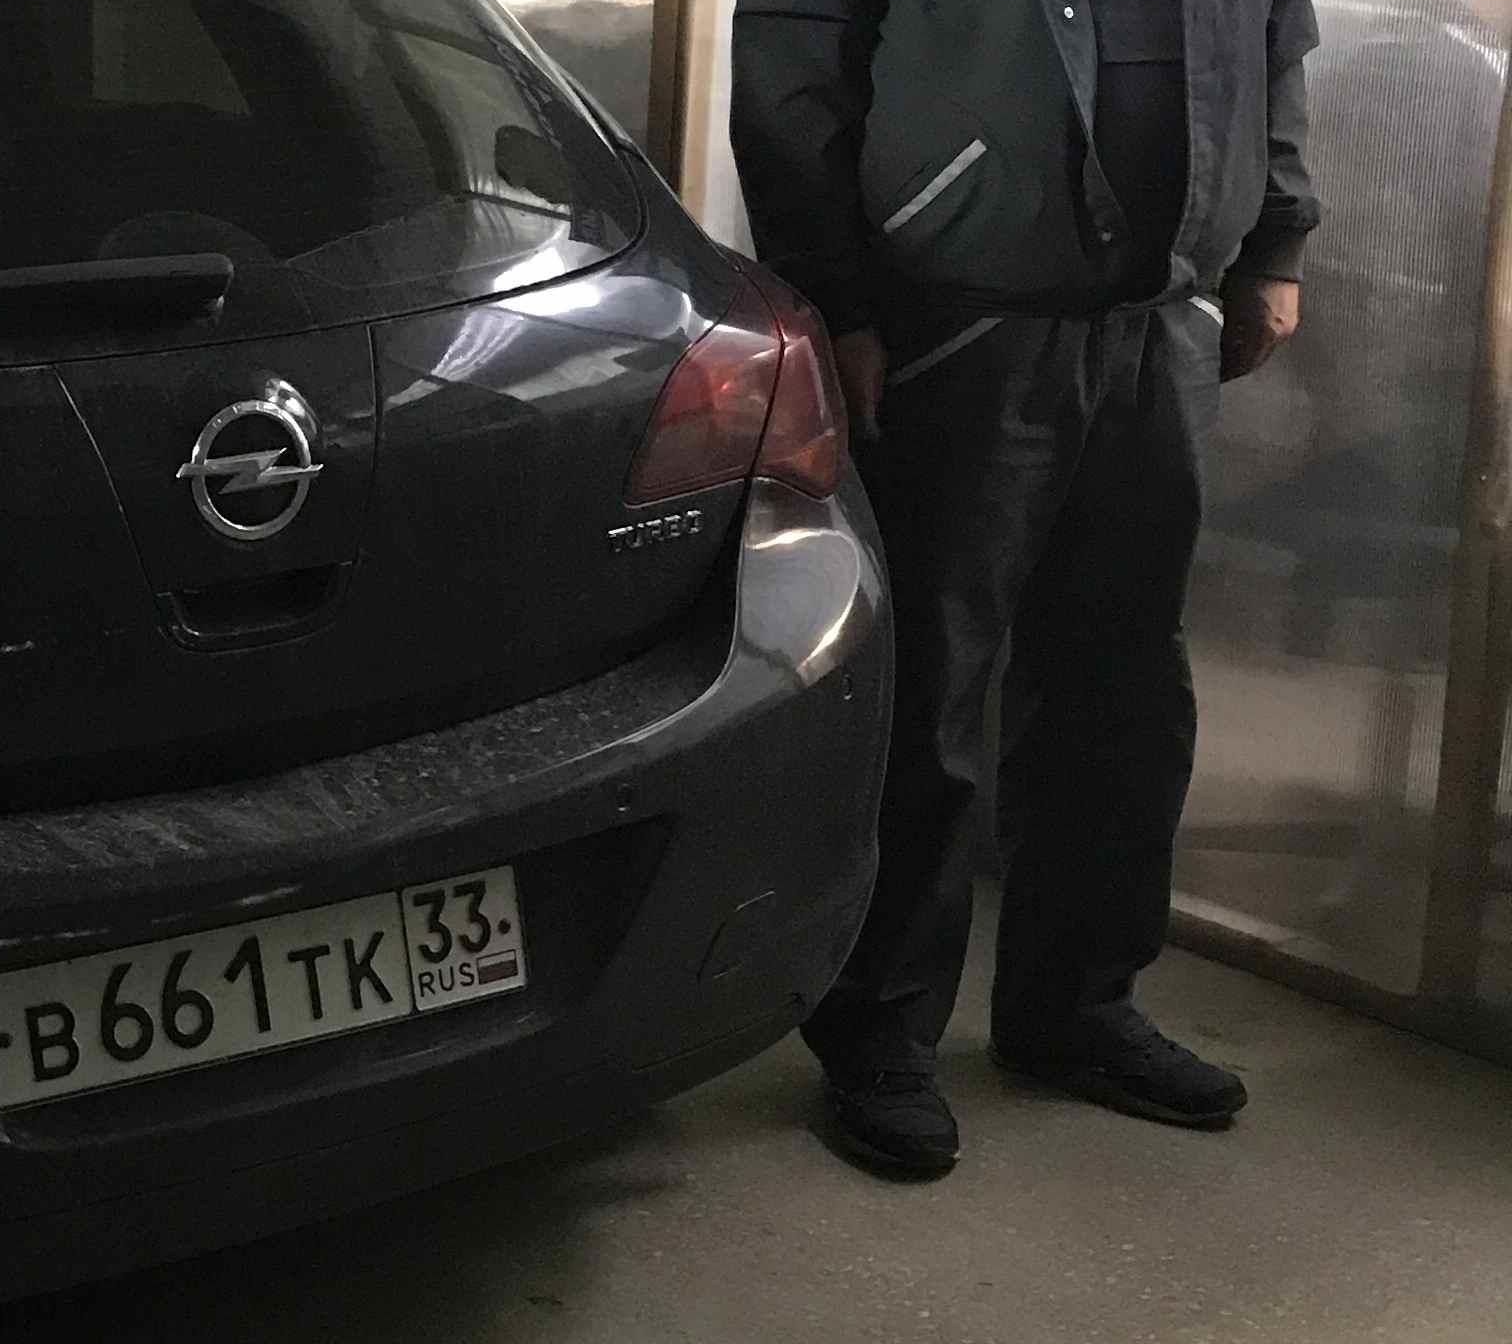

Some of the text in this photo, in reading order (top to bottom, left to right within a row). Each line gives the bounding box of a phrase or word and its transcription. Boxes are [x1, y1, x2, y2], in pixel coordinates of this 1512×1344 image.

[24, 880, 493, 1083] В661ТК 33
[417, 961, 476, 998] RUS
